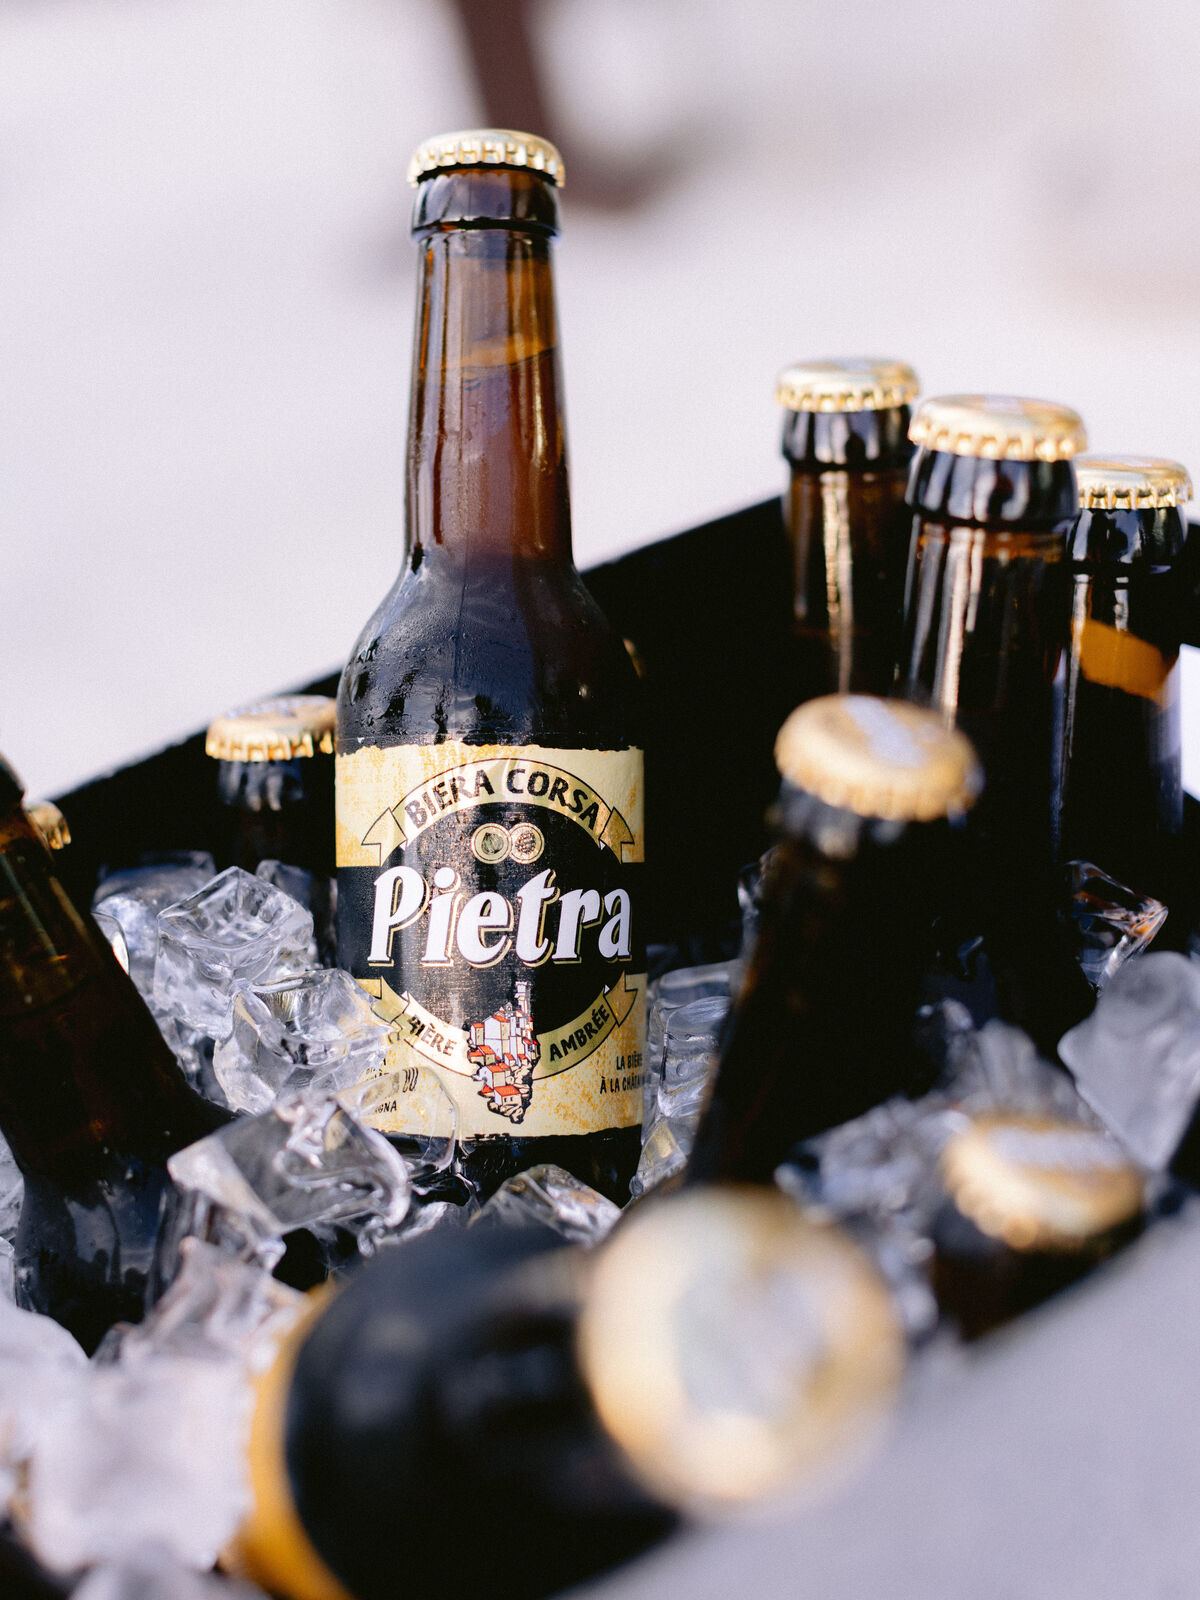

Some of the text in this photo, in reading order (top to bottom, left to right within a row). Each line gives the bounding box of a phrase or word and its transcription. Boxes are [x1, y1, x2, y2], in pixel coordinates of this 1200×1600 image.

[405, 768, 599, 829] BIERA CORSA
[367, 865, 632, 968] Pietra
[549, 1004, 610, 1061] AMBRÉE
[600, 1075, 607, 1094] À
[610, 1077, 620, 1093] LA
[616, 1055, 625, 1070] LA
